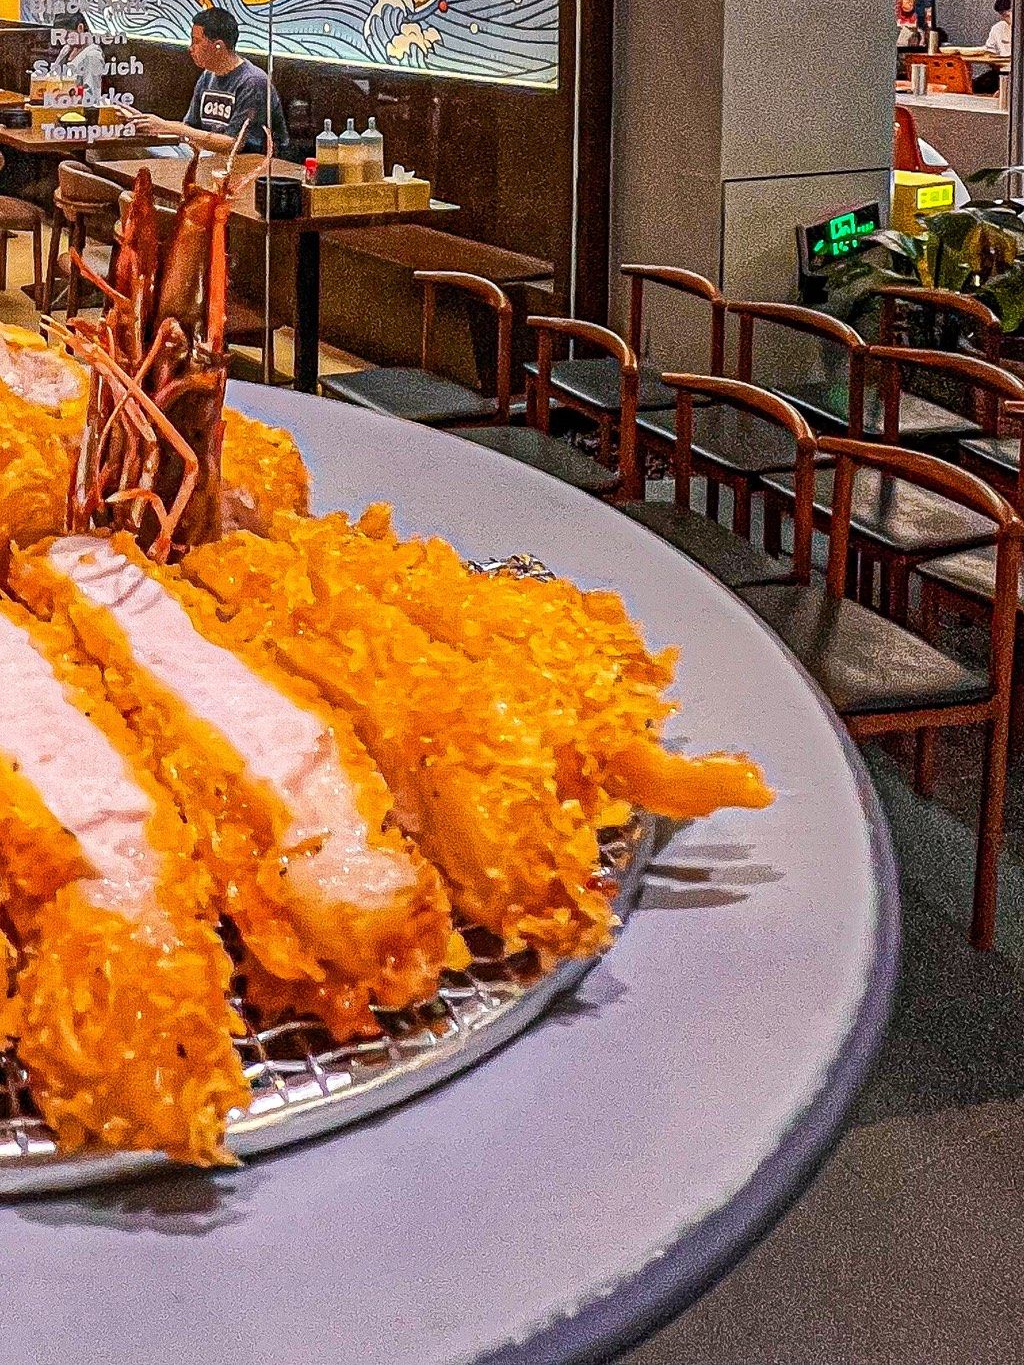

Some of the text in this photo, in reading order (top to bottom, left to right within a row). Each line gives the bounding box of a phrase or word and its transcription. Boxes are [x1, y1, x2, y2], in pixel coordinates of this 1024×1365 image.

[50, 28, 128, 46] Ramen
[32, 55, 144, 77] Sanich
[40, 122, 137, 144] Tempura
